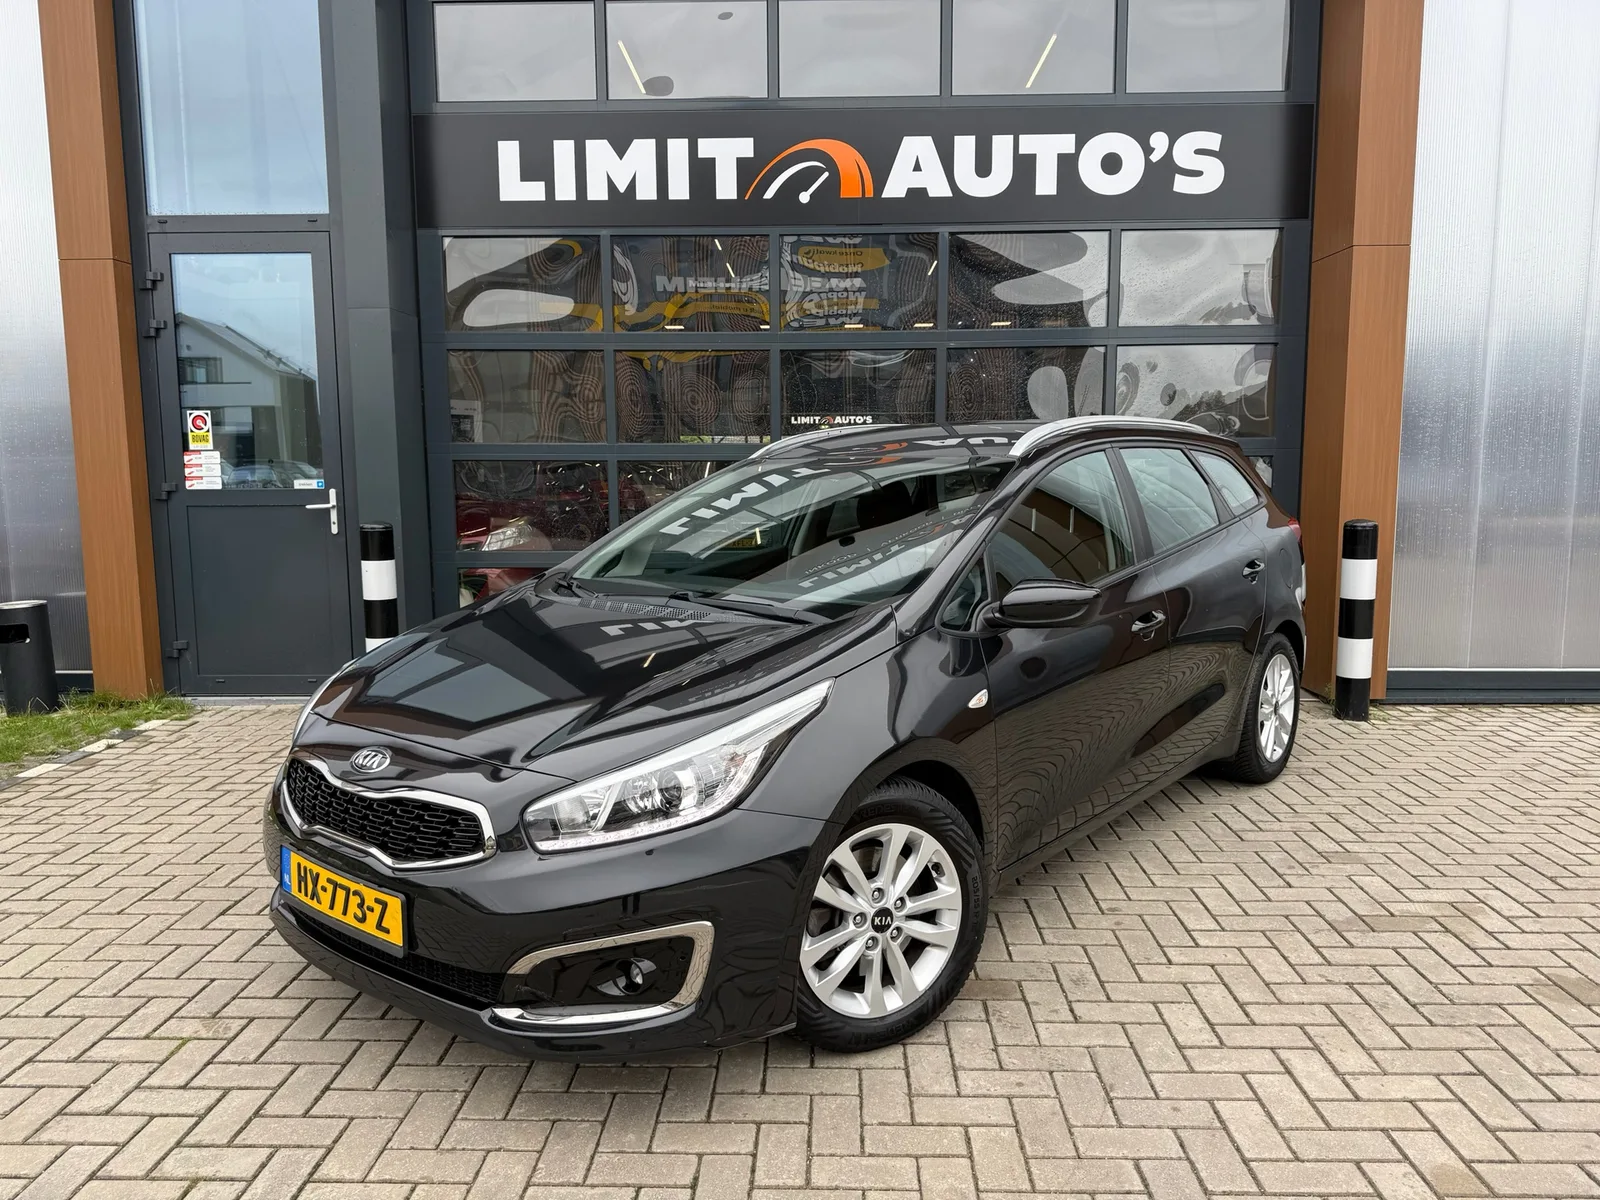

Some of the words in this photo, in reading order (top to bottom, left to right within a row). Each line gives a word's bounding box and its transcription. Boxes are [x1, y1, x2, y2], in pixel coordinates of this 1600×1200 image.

[497, 138, 754, 202] LIMIT
[881, 131, 1225, 198] AUTO'S
[791, 416, 821, 425] LIMIT
[833, 415, 873, 424] AUTO'S
[191, 434, 210, 443] BOVAG
[353, 748, 385, 769] KIA
[283, 873, 291, 886] NL
[296, 861, 391, 935] HX-773-Z
[873, 916, 892, 926] KIA
